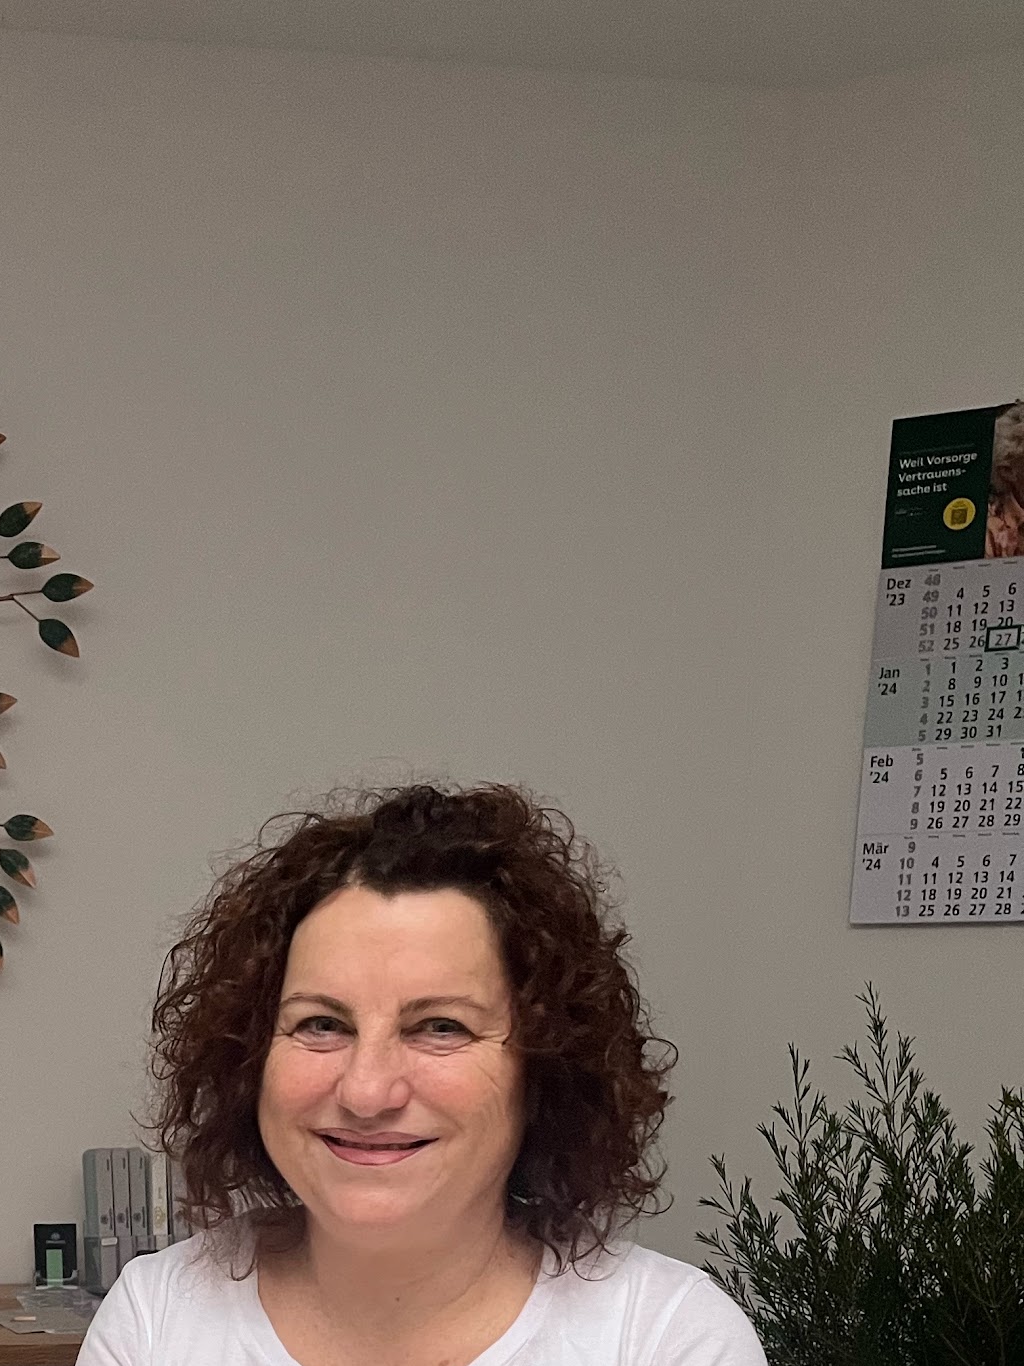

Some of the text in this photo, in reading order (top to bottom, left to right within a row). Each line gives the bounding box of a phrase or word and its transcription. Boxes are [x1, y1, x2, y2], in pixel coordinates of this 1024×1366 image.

[900, 452, 977, 469] Weil Vorsorge
[898, 468, 966, 482] Vertrauens-
[897, 482, 947, 497] sache ist
[887, 578, 911, 590] Dez
[957, 588, 964, 599] 4
[983, 585, 990, 597] 5
[1009, 583, 1016, 595] 6
[948, 605, 961, 617] 11
[974, 602, 988, 614] 12
[1000, 600, 1014, 612] 13
[947, 621, 961, 633] 18
[972, 619, 987, 631] 19
[944, 638, 959, 650] 25
[970, 636, 985, 648] 26
[995, 633, 1011, 646] 27
[951, 662, 956, 673] 1
[976, 660, 983, 671] 2
[1001, 657, 1009, 670] 3
[879, 667, 900, 679] Jan
[948, 678, 956, 690] 8
[974, 676, 981, 688] 9
[992, 675, 1007, 686] 10
[940, 695, 954, 707] 15
[965, 693, 980, 705] 16
[991, 691, 1006, 703] 17
[937, 712, 953, 724] 22
[962, 710, 978, 722] 23
[988, 708, 1004, 720] 24
[935, 728, 951, 740] 29
[960, 726, 977, 739] 30
[986, 725, 1002, 738] 31
[870, 755, 893, 767] Feb
[916, 753, 923, 765] 5
[915, 769, 922, 781] 6
[940, 768, 947, 780] 5
[966, 767, 973, 779] 6
[992, 765, 999, 777] 7
[914, 781, 1024, 797] 7 12 13 14 15
[911, 797, 1022, 814] 8 19 20 21 22
[910, 814, 1021, 830] 9 26 27 28 29
[863, 842, 889, 855] Mär
[908, 842, 915, 853] 9
[900, 854, 1017, 869] 10 4 5 6 7
[899, 871, 1014, 885] 11 11 12 13 14
[897, 887, 1012, 901] 12 18 19 20 21
[896, 903, 1011, 917] 13 25 26 27 28
